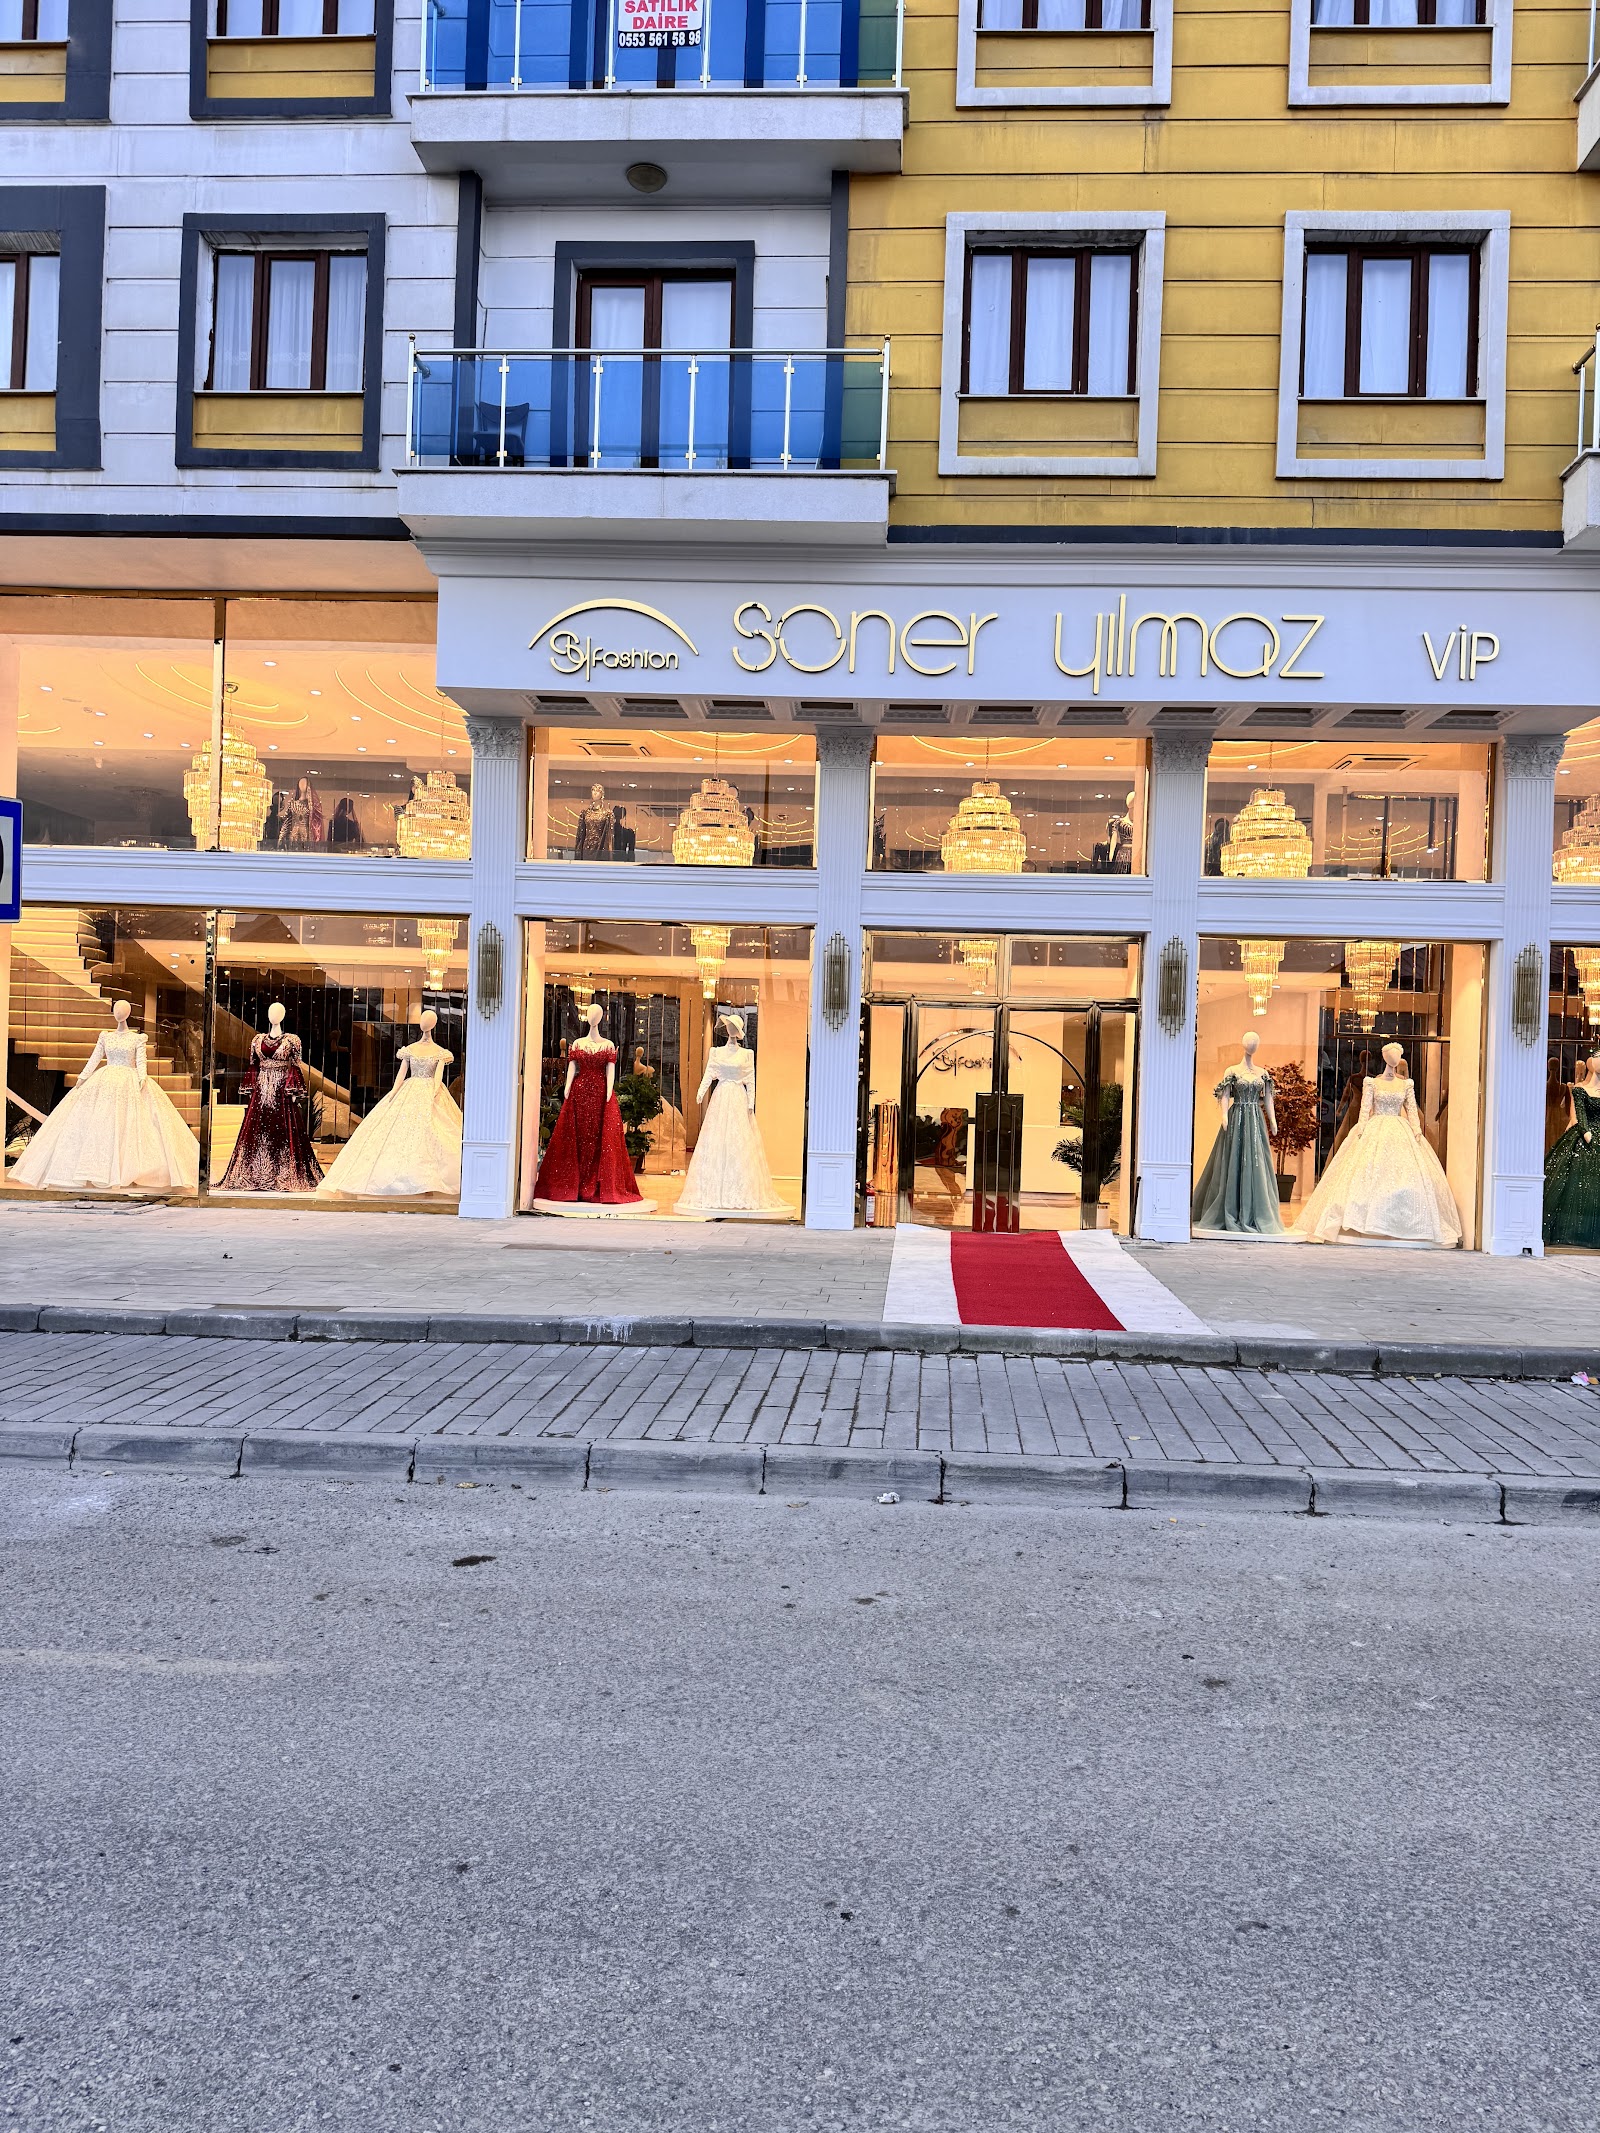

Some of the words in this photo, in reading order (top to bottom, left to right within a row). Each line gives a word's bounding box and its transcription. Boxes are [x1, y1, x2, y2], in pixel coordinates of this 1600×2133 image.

[624, 0, 698, 13] SATILIK
[632, 13, 688, 29] DAİRE
[618, 32, 646, 47] 0553
[648, 32, 668, 47] 561
[671, 31, 686, 46] 58
[688, 30, 701, 46] 98
